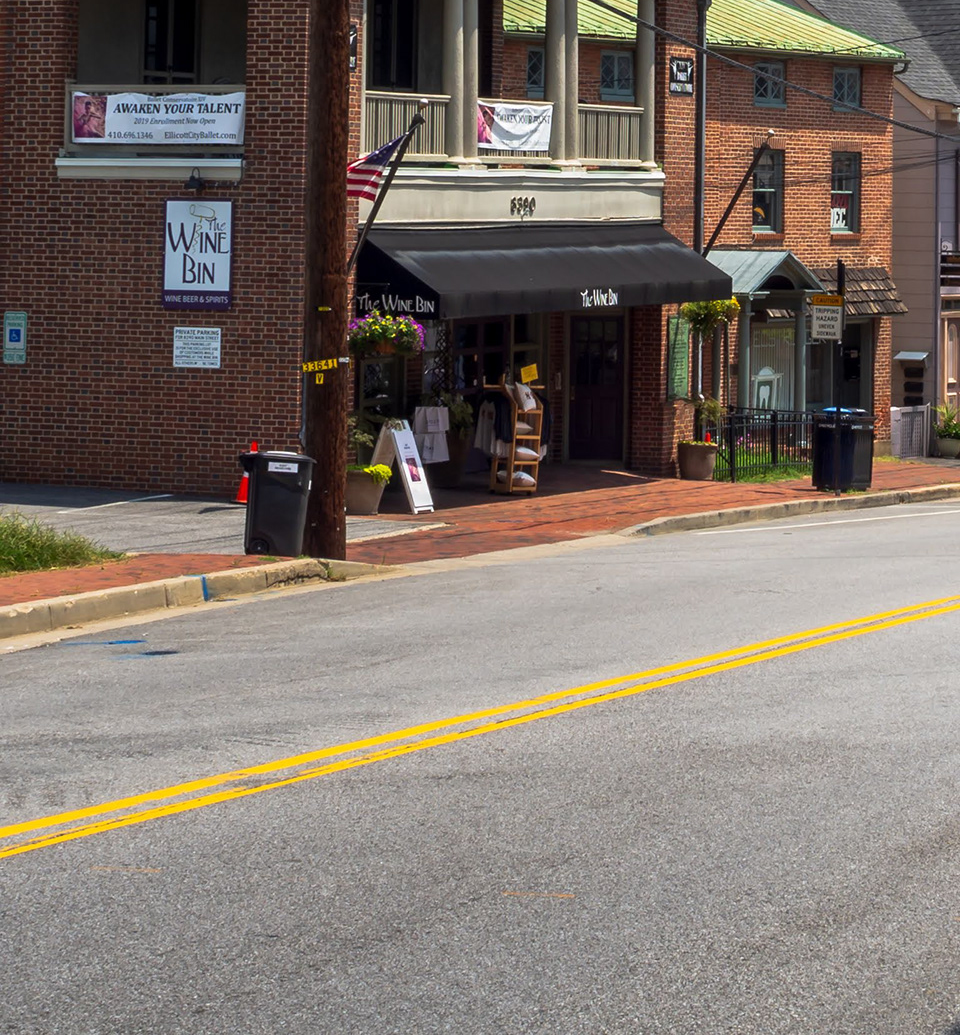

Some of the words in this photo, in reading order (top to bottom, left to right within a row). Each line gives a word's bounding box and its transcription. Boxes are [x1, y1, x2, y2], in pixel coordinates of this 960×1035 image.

[113, 103, 160, 114] AWAKEN
[164, 103, 194, 114] YOUR
[197, 103, 242, 114] TALENT
[199, 118, 216, 126] Open
[107, 131, 153, 140] 410.696.1346
[164, 131, 236, 140] EllicottCityBallet.com
[167, 222, 229, 254] WINE
[182, 253, 215, 284] BIN
[356, 292, 380, 310] The
[416, 295, 435, 313] BIN
